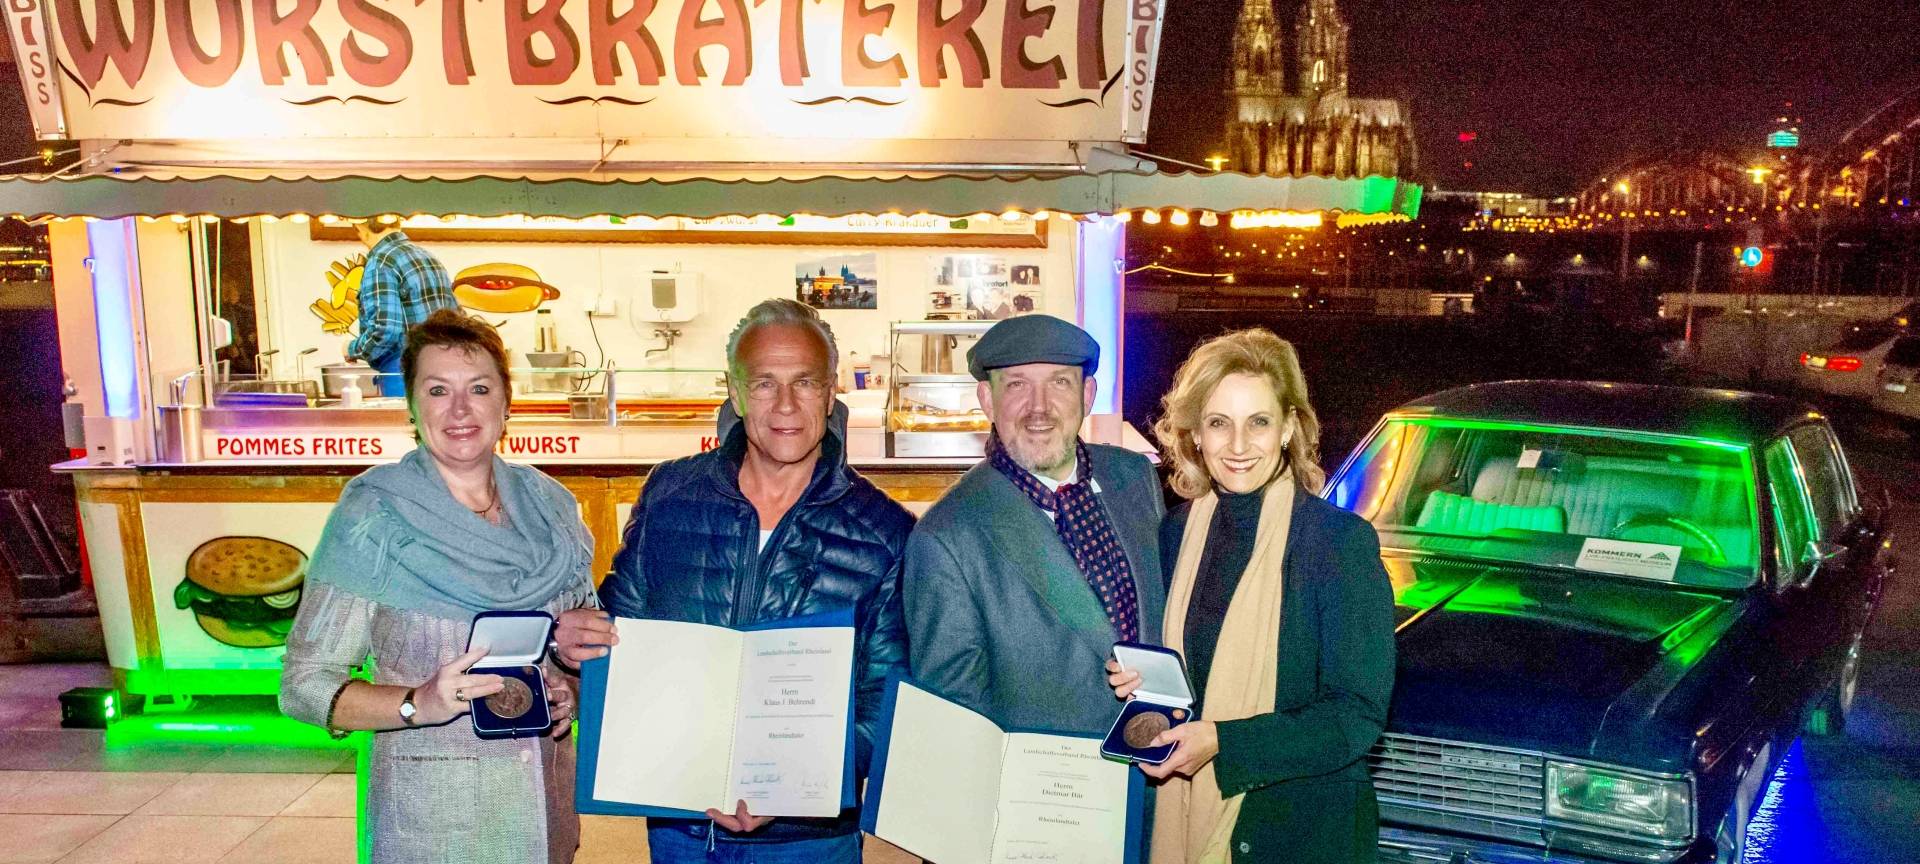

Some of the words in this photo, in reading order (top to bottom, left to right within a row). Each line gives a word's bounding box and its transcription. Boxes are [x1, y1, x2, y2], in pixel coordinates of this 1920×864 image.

[55, 0, 1106, 89] WURSTBRATEREI
[217, 438, 305, 455] POMMES
[313, 438, 383, 455] FRITES
[495, 437, 580, 453] TWURST
